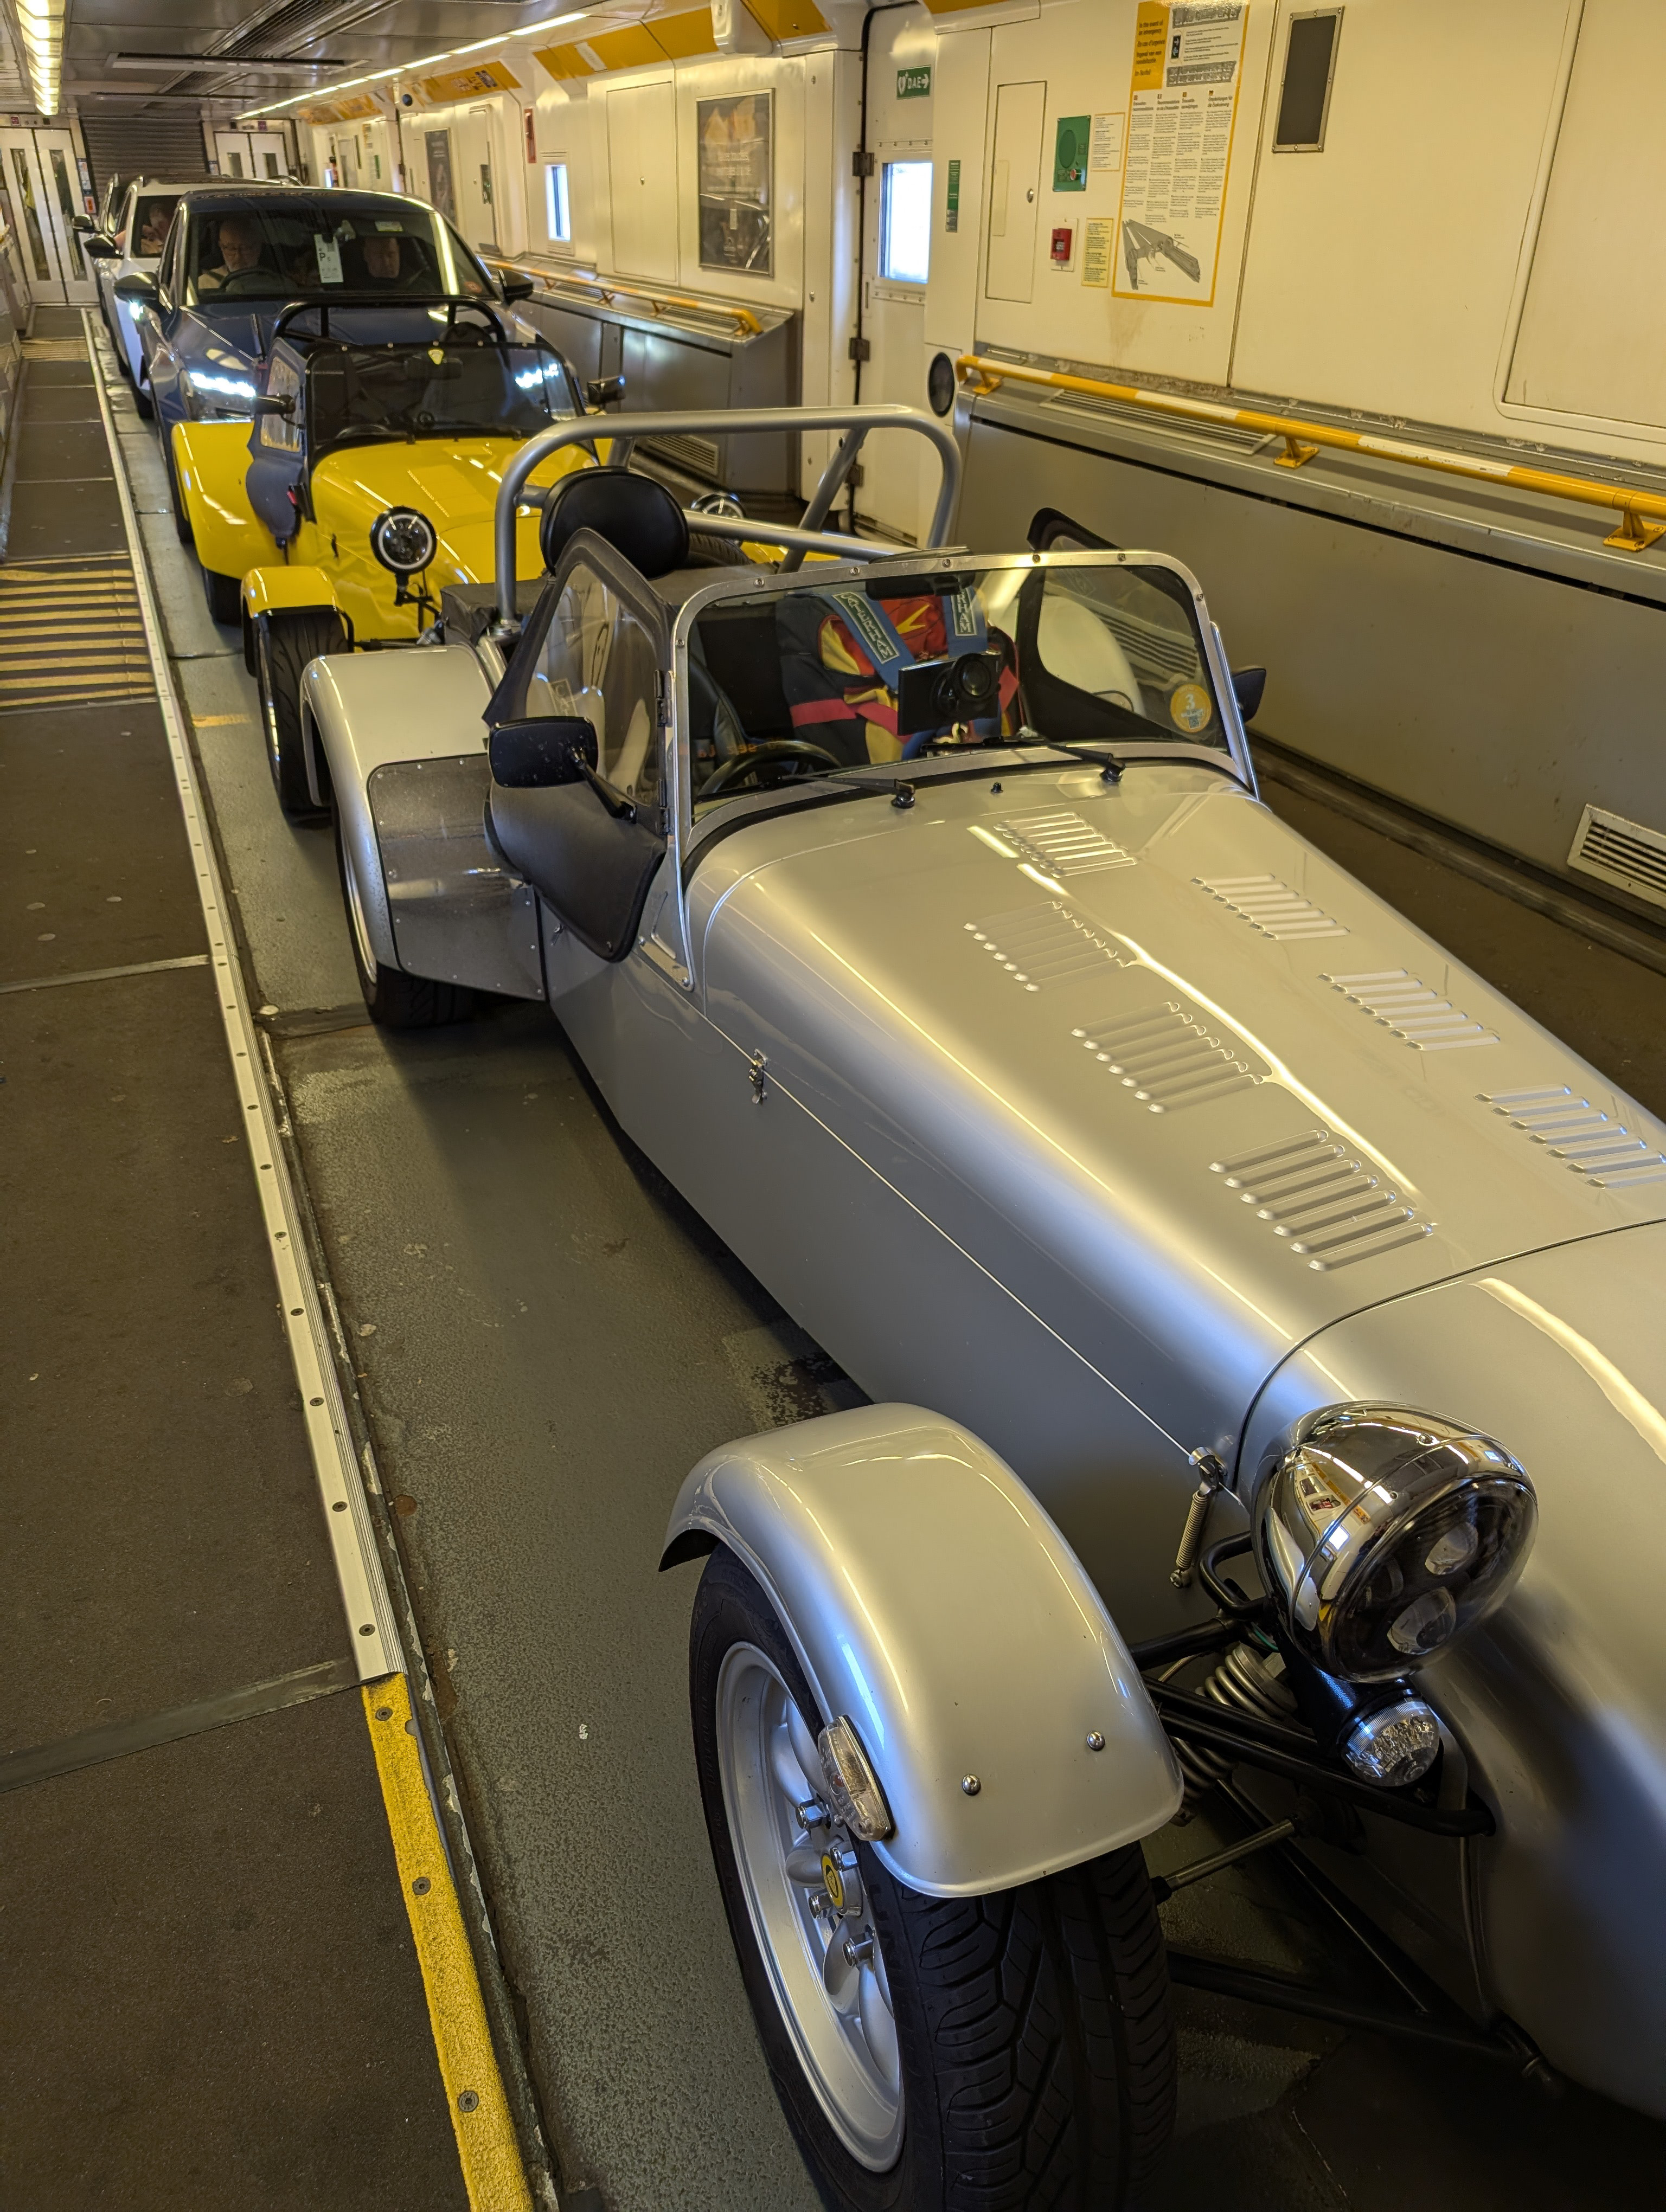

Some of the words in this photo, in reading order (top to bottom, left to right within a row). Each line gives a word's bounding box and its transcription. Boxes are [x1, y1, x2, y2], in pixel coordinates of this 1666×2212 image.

[907, 76, 922, 89] DAE
[841, 593, 893, 659] CATERHAM
[956, 590, 972, 633] RHAM
[1186, 693, 1196, 710] 3
